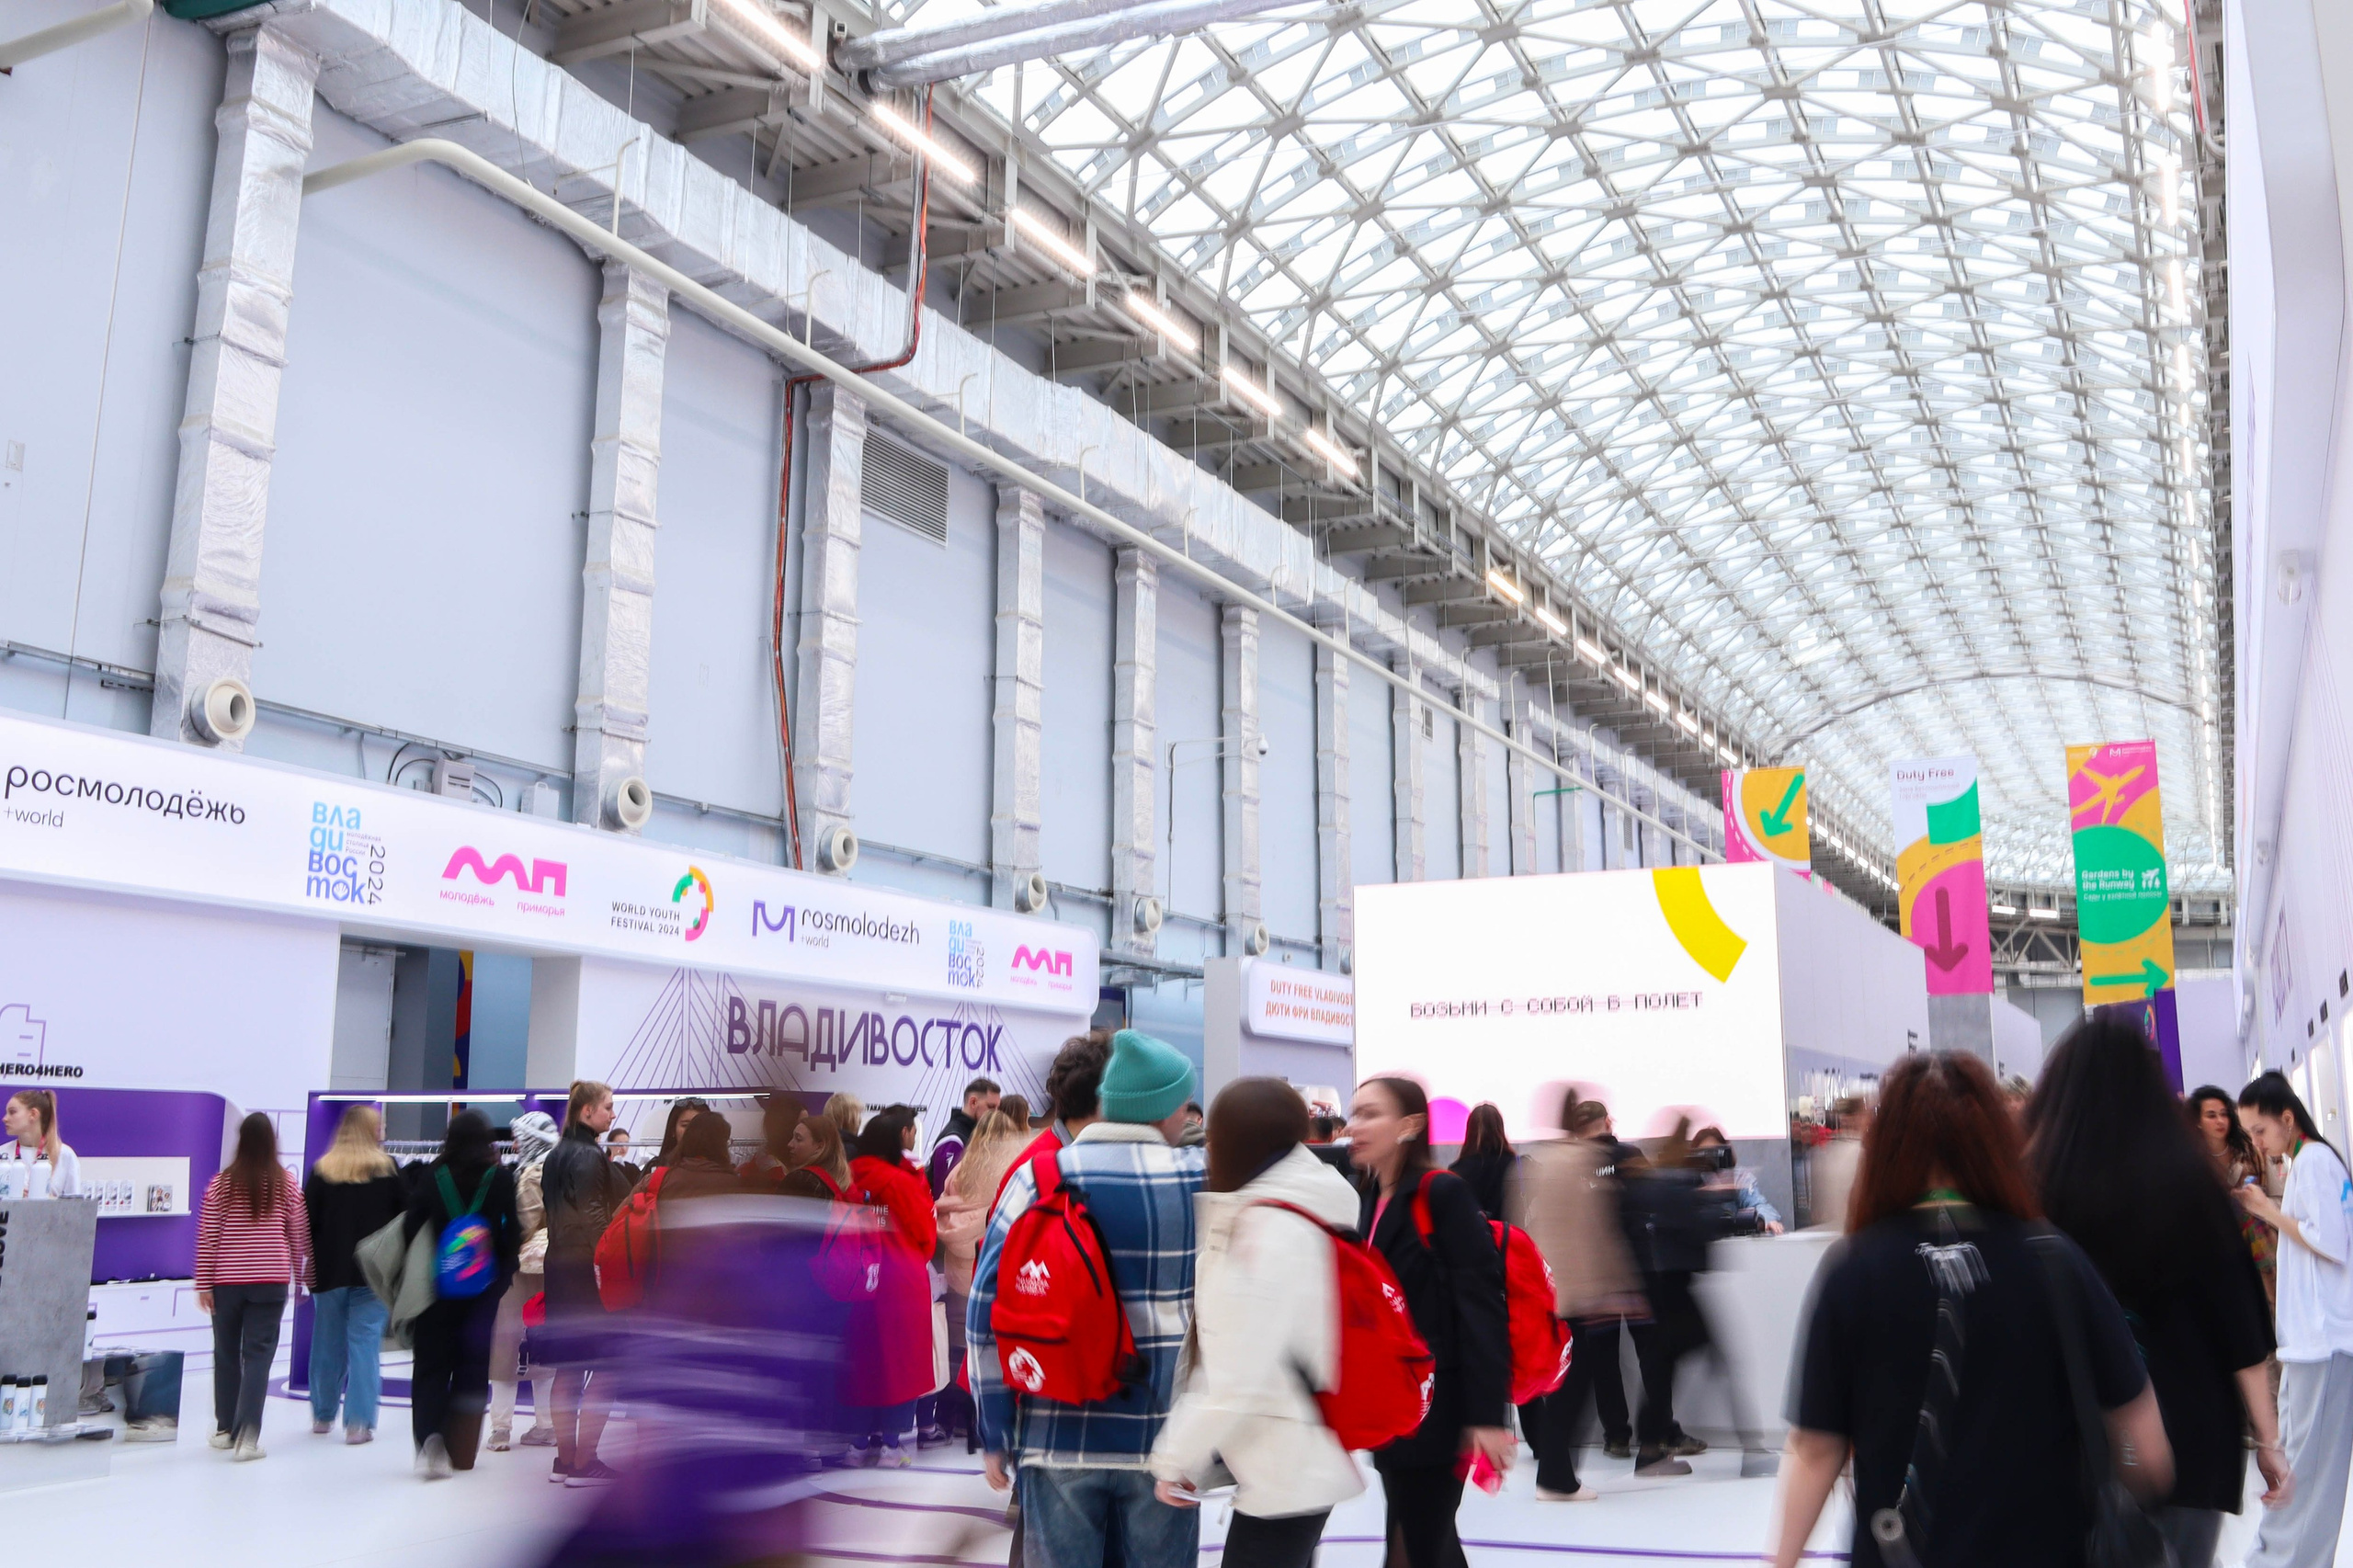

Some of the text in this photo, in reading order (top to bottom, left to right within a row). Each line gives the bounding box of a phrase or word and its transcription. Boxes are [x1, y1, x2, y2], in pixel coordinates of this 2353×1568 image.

[1896, 767, 1954, 783] Duty Free
[5, 765, 246, 825] росмолодёжь
[368, 844, 386, 905] 2024
[2121, 868, 2134, 880] by
[2082, 880, 2097, 892] the
[439, 889, 565, 917] молодёжь приморья
[611, 901, 680, 921] WORLD YOUTH
[610, 915, 679, 936] FESTIVAL 2024
[801, 908, 920, 946] rosmolodezh
[1270, 979, 1291, 995] DUTY
[1294, 983, 1313, 999] FREE
[1265, 1000, 1290, 1018] ДЮТИ
[1292, 1005, 1309, 1020] ФРИ
[1411, 990, 1702, 1020] ВОЗЬМИ С СОБОЙ В ПОЛЕТ
[727, 995, 1004, 1074] ВЛАДИВОСТОК
